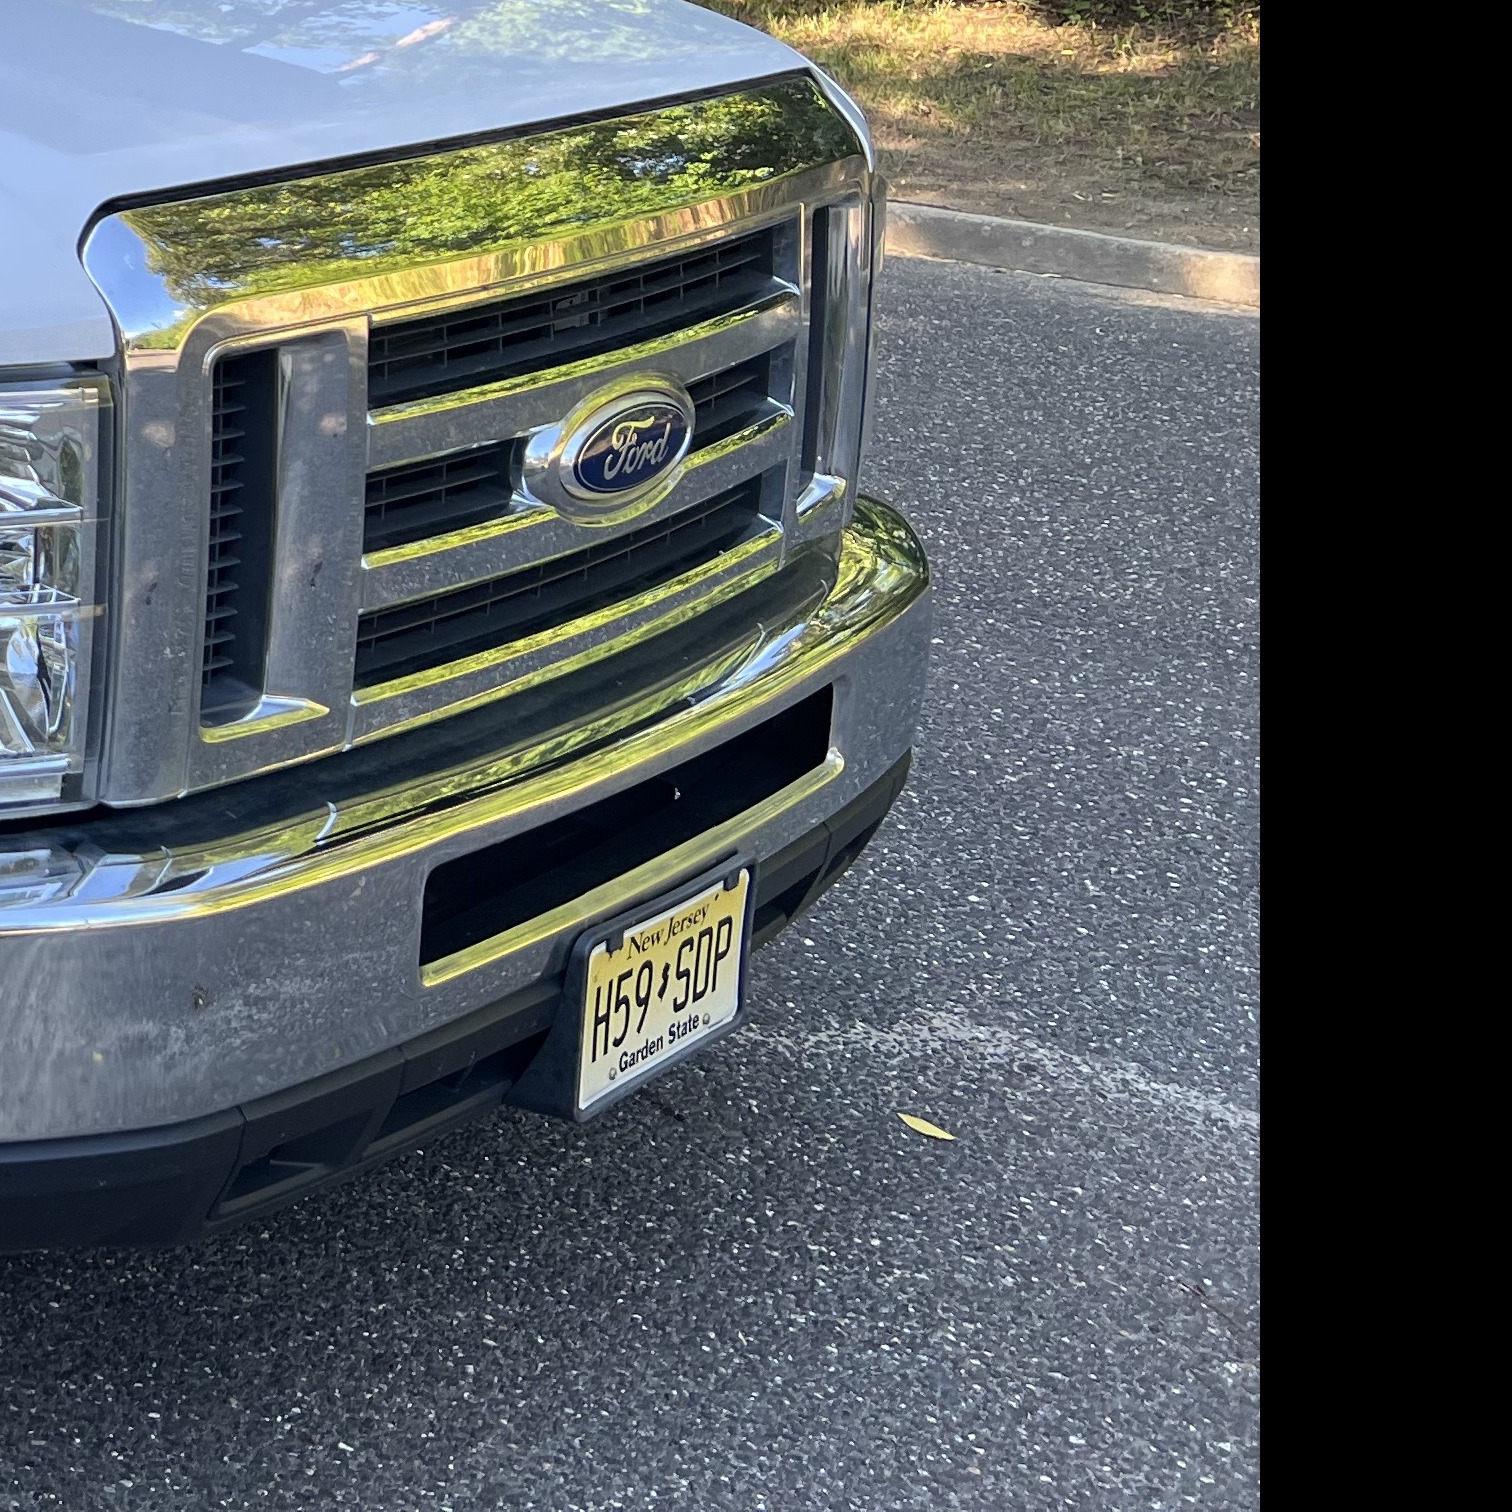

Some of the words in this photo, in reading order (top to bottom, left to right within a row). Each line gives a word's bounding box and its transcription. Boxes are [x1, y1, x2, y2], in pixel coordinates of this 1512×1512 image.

[603, 415, 671, 480] Ford
[627, 931, 664, 960] New
[664, 903, 709, 946] Jersey
[619, 1035, 663, 1072] Garden
[668, 1013, 700, 1044] State
